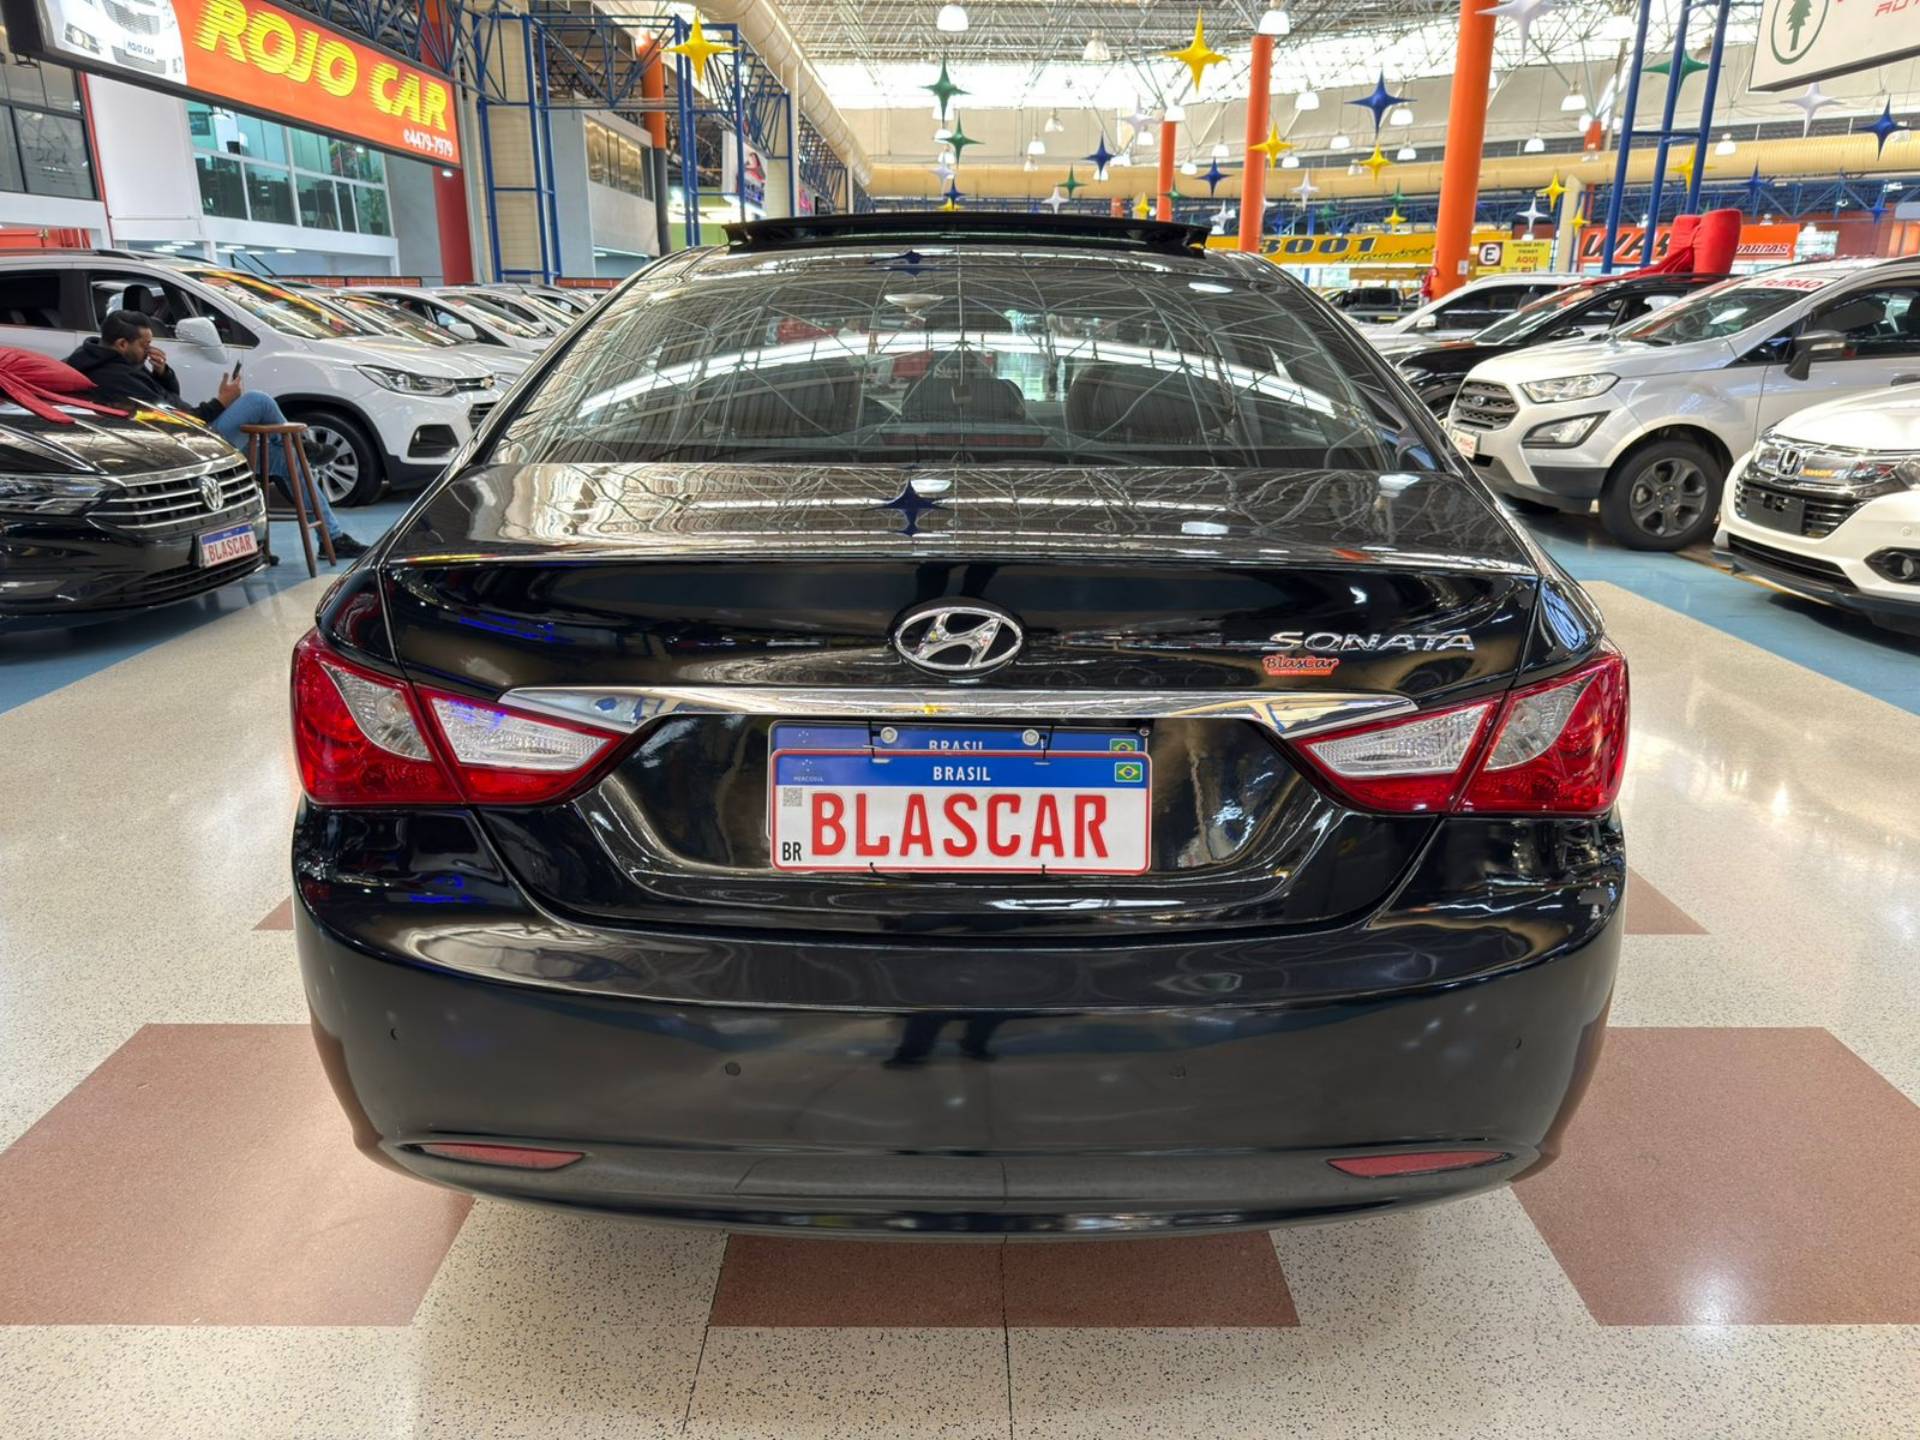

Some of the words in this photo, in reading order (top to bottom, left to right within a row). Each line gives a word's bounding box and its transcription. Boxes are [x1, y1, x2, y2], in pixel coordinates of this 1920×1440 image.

[193, 0, 358, 97] ROJO
[368, 61, 448, 131] CAR
[1484, 246, 1496, 262] E
[208, 534, 253, 562] BLASCAR
[1261, 630, 1476, 651] SONATA
[933, 765, 992, 781] BRASIL
[811, 793, 1109, 858] BLASCAR
[782, 841, 803, 863] BR
